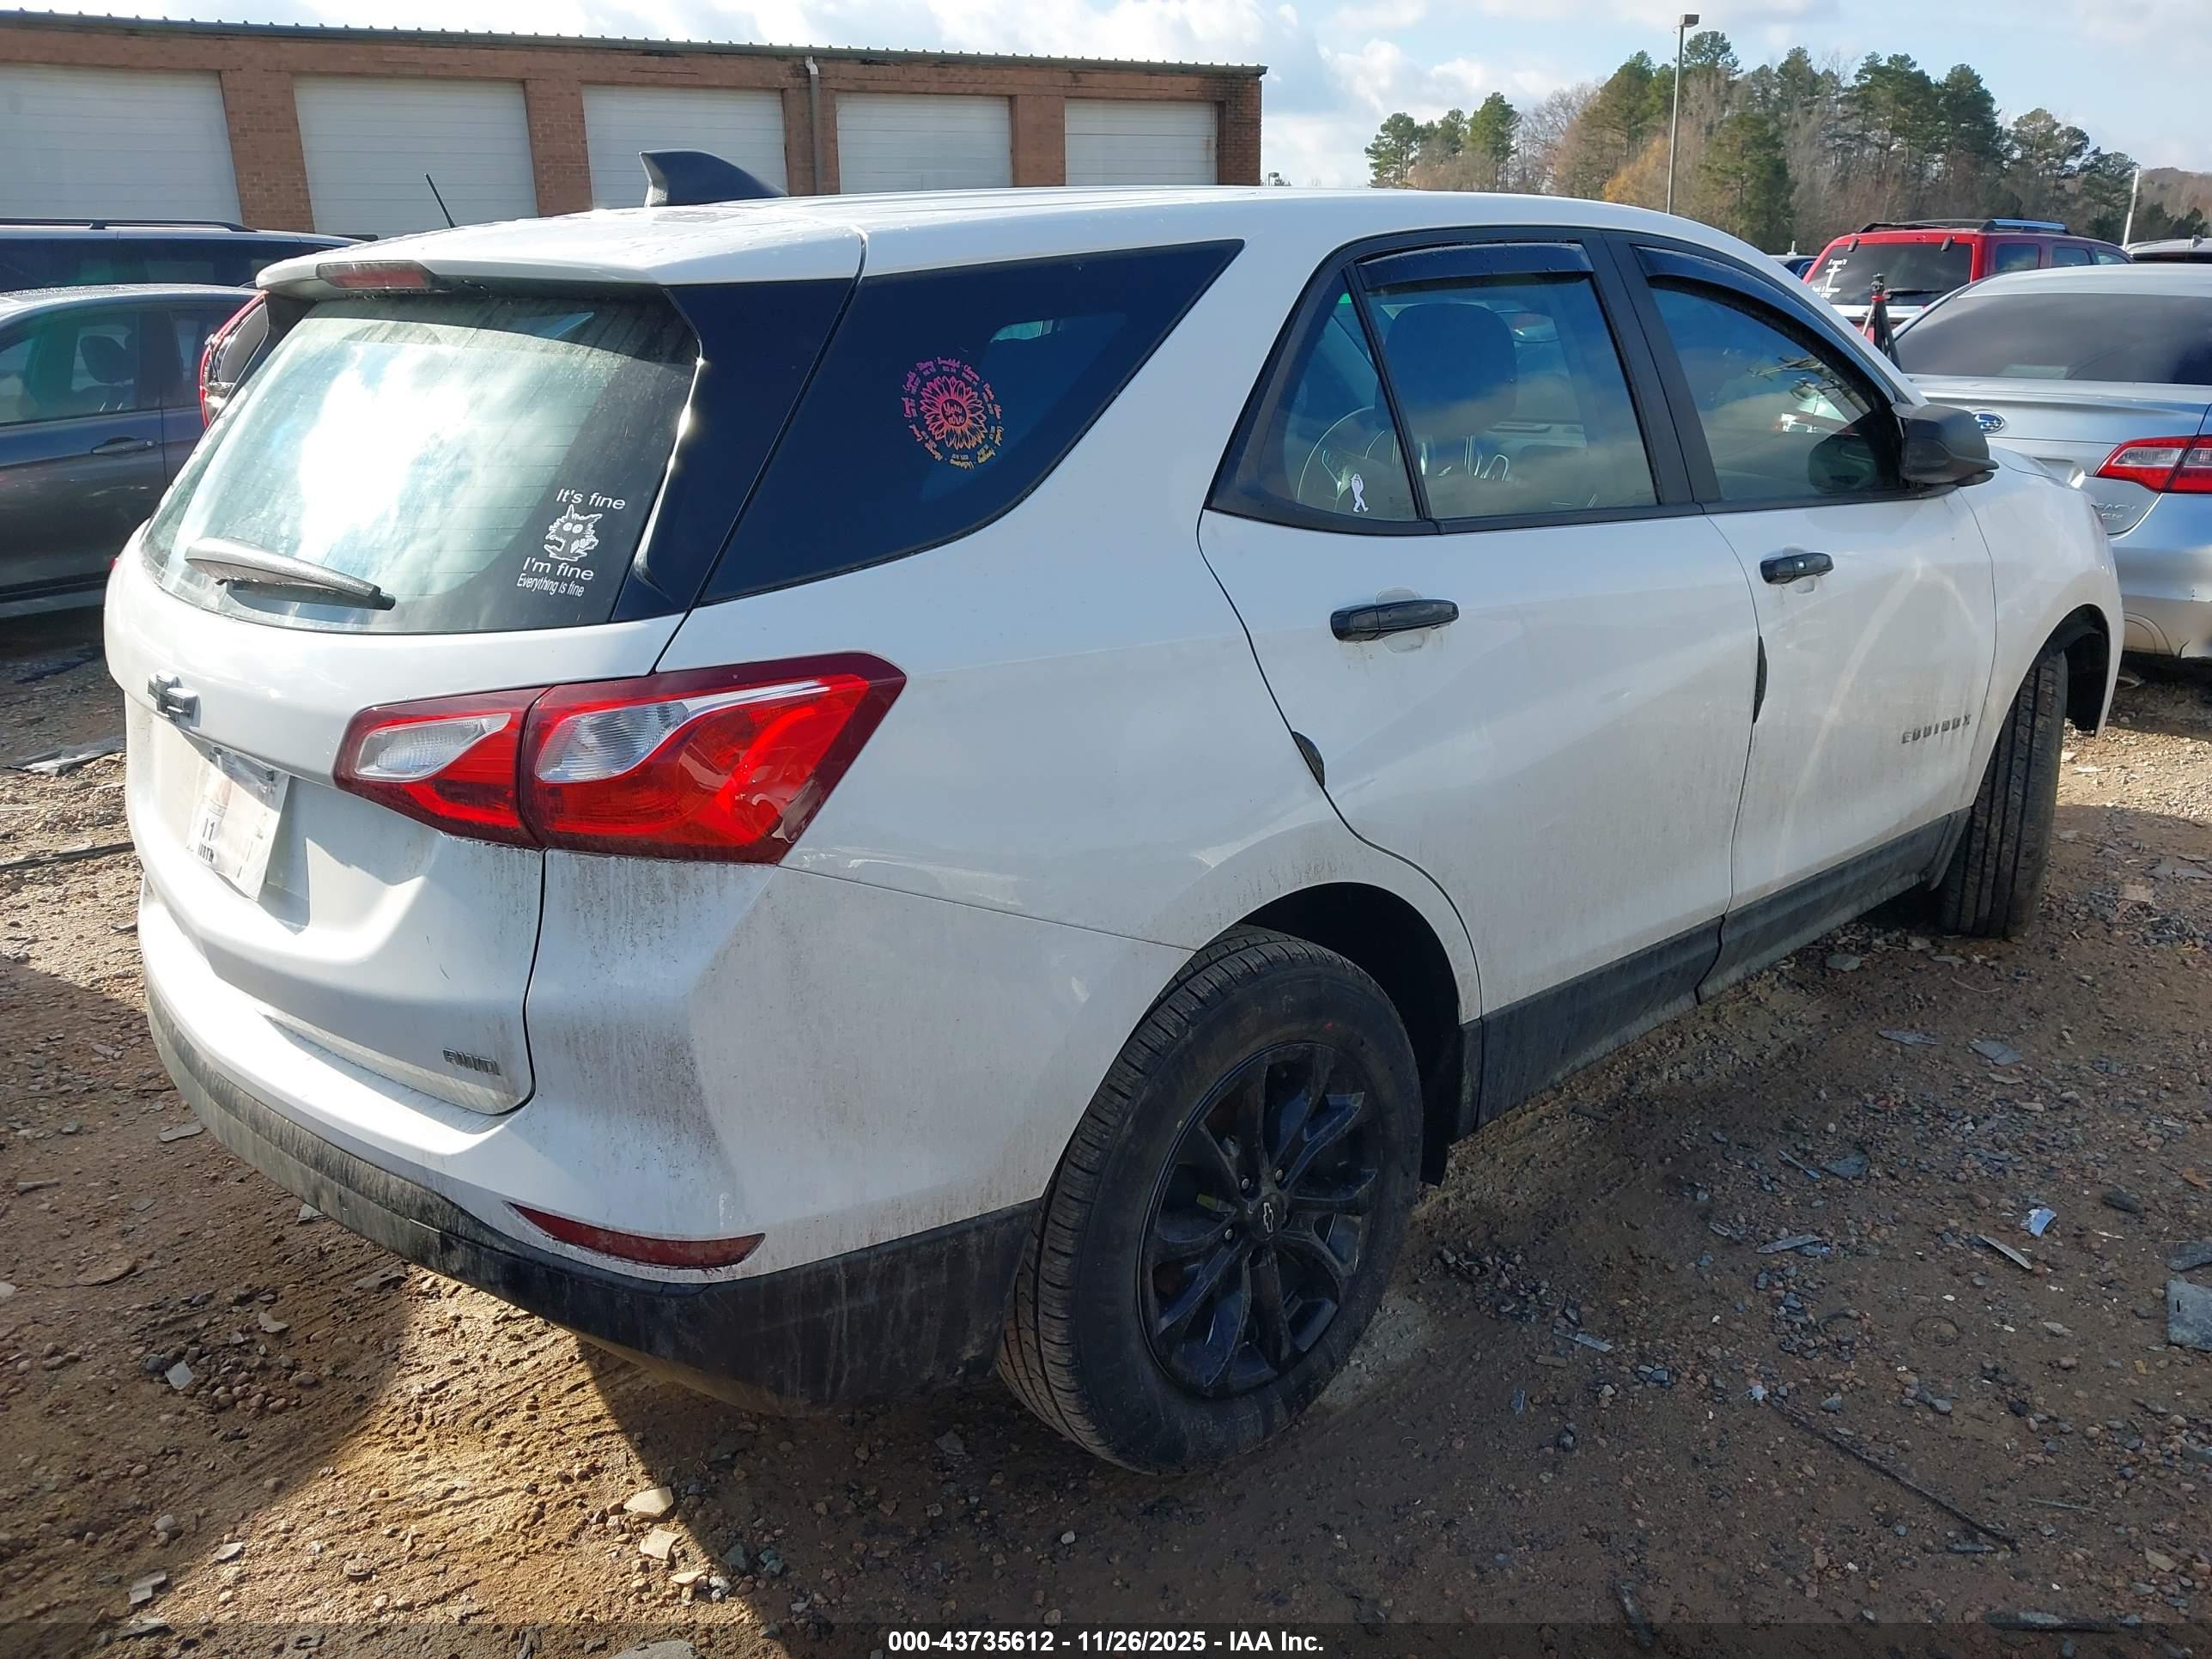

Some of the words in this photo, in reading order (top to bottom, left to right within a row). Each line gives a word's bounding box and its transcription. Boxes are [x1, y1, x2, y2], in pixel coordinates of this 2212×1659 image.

[556, 488, 584, 505] It's
[588, 492, 626, 510] fine
[522, 556, 551, 574] I'm
[556, 562, 594, 581] fine
[516, 573, 559, 596] Everything
[559, 580, 567, 594] is
[568, 580, 585, 598] fine
[1901, 714, 1972, 744] EQUINOX
